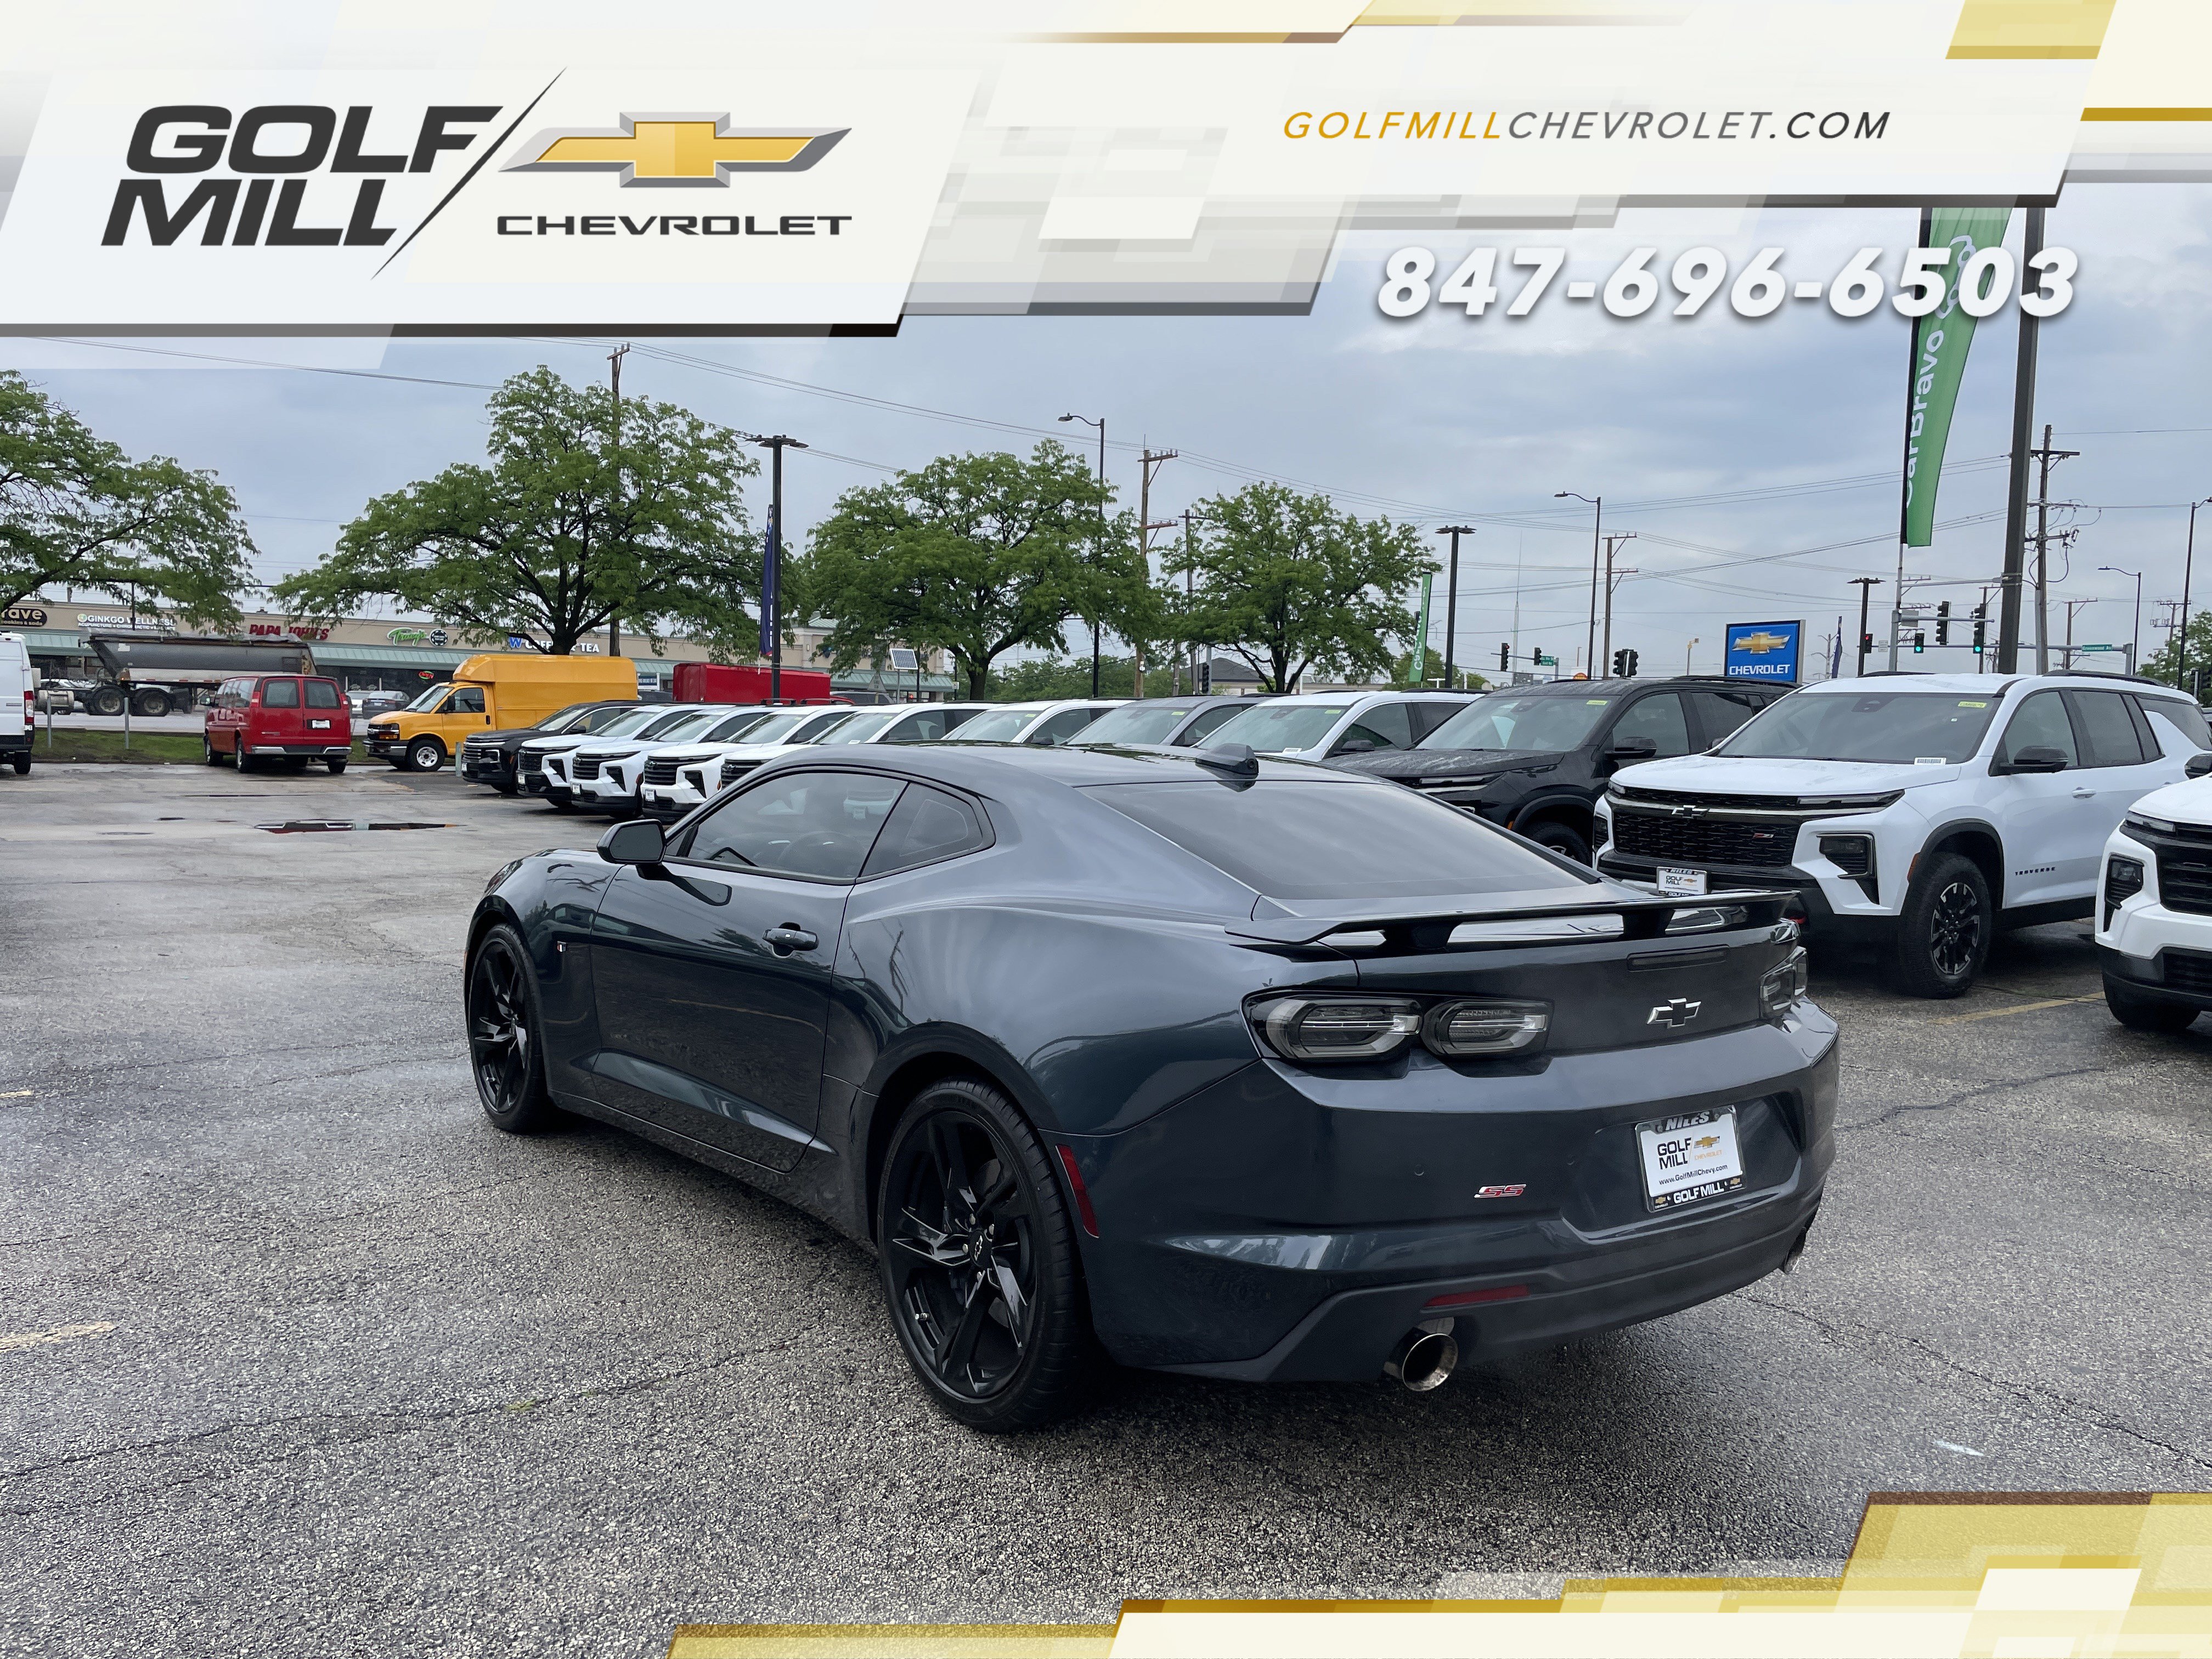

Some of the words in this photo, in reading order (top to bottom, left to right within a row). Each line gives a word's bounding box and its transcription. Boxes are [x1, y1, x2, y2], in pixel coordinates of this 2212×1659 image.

[88, 615, 125, 624] GINKGO
[126, 617, 176, 626] ELLNS
[249, 624, 281, 636] PAPA
[289, 626, 329, 640] JOHNS
[580, 643, 600, 653] TEA
[1729, 664, 1791, 675] CHEVROLET
[1666, 1111, 1710, 1131] NILES
[1657, 1137, 1692, 1156] GOLF
[1658, 1152, 1688, 1170] MILL
[1694, 1150, 1723, 1161] CHEVROLET
[1658, 1164, 1728, 1185] www.GolfMillChevy.com
[1474, 1183, 1526, 1198] SS
[1673, 1187, 1700, 1204] GOLF
[1700, 1182, 1725, 1197] MILL
